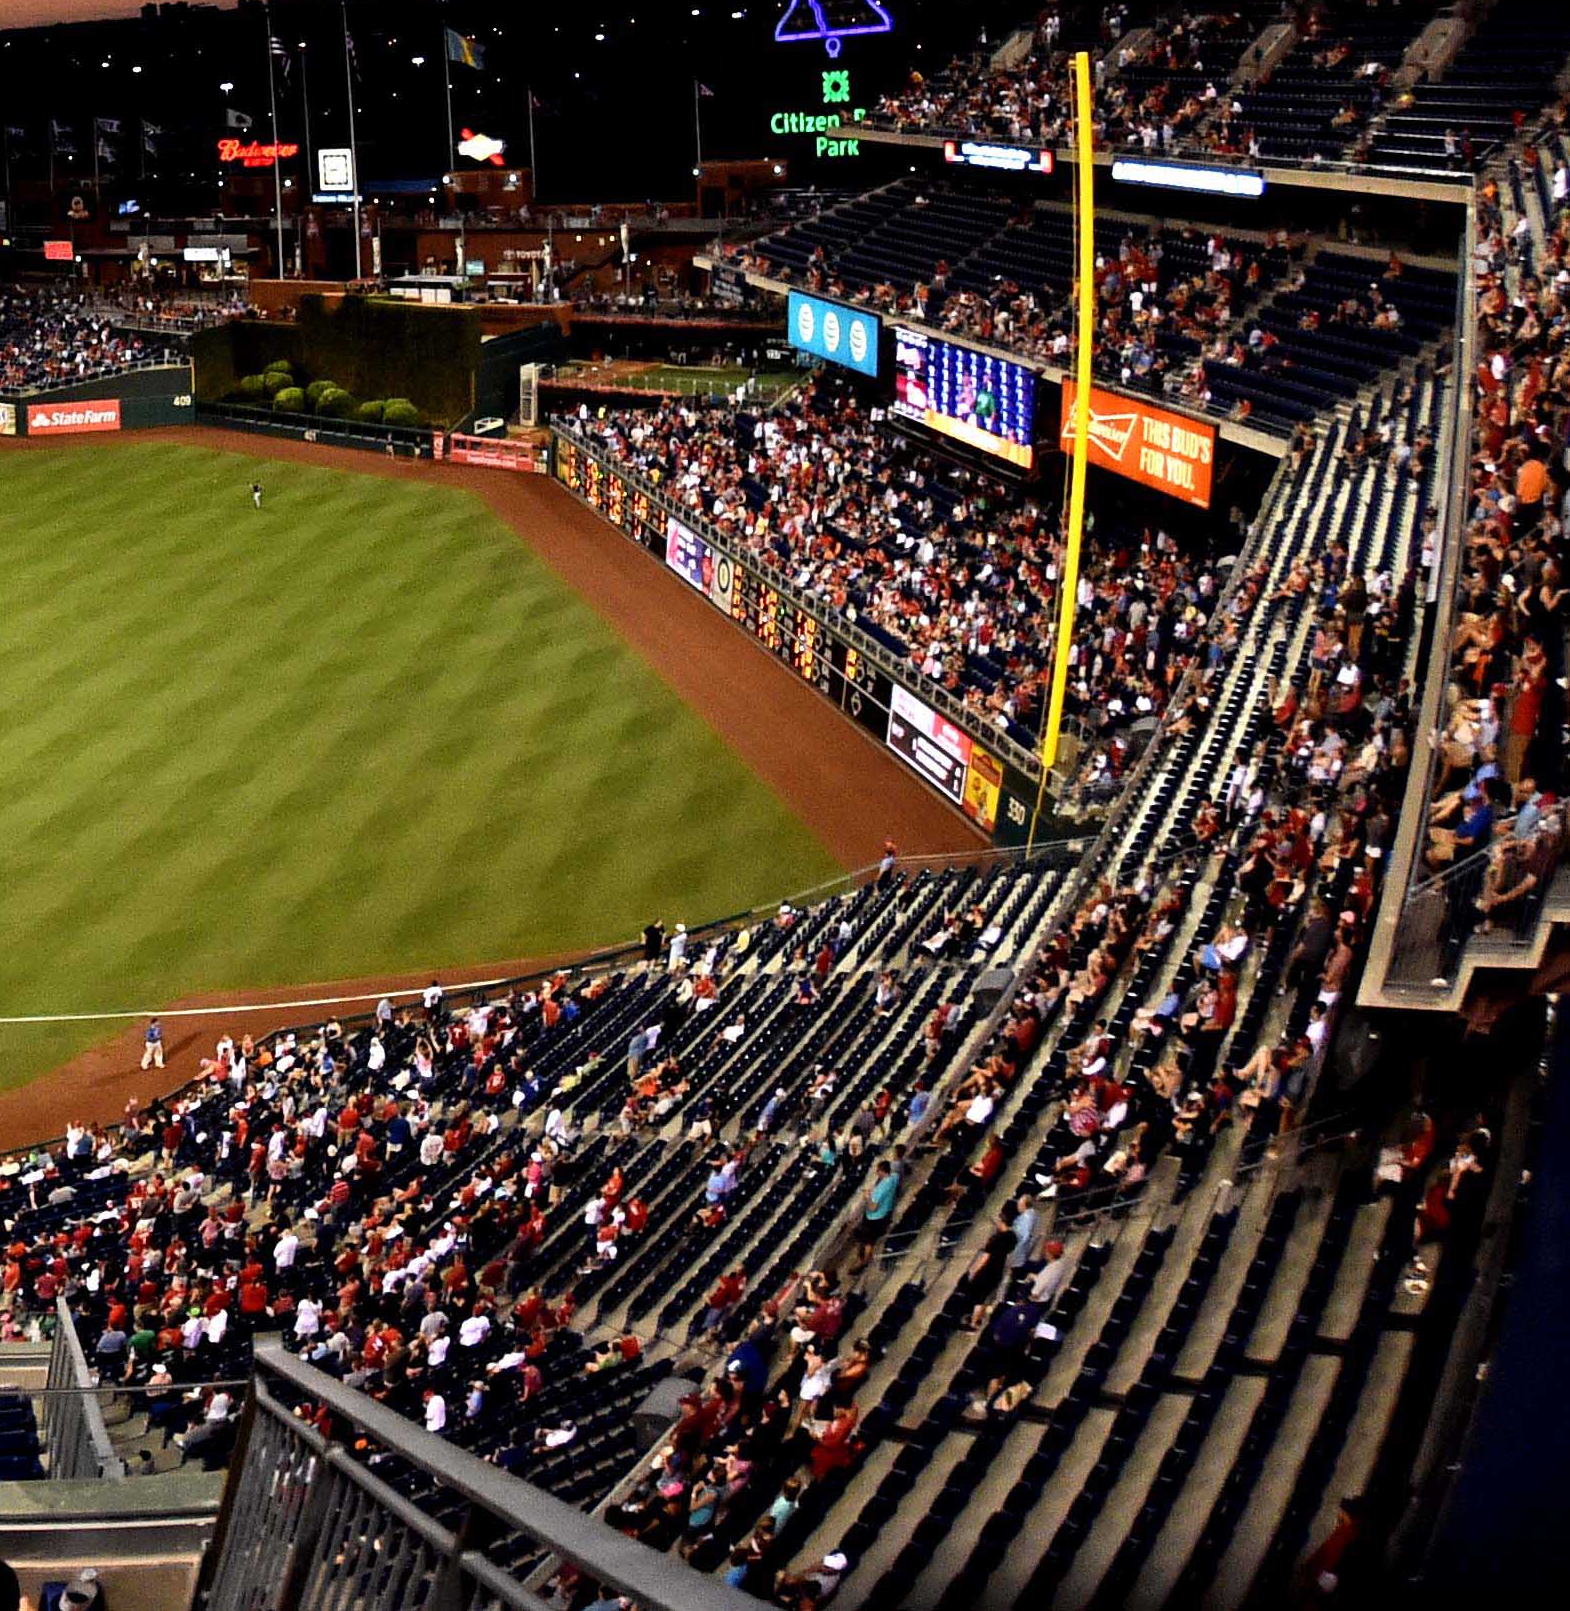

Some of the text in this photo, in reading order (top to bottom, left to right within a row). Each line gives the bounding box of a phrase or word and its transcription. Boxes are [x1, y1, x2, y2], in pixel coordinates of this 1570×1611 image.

[770, 112, 840, 134] Citizen
[218, 139, 299, 161] Budweiser
[816, 137, 859, 157] Park
[173, 395, 191, 407] 409
[1143, 417, 1211, 464] THIS BUD'S
[1140, 447, 1195, 491] FOR YOU.
